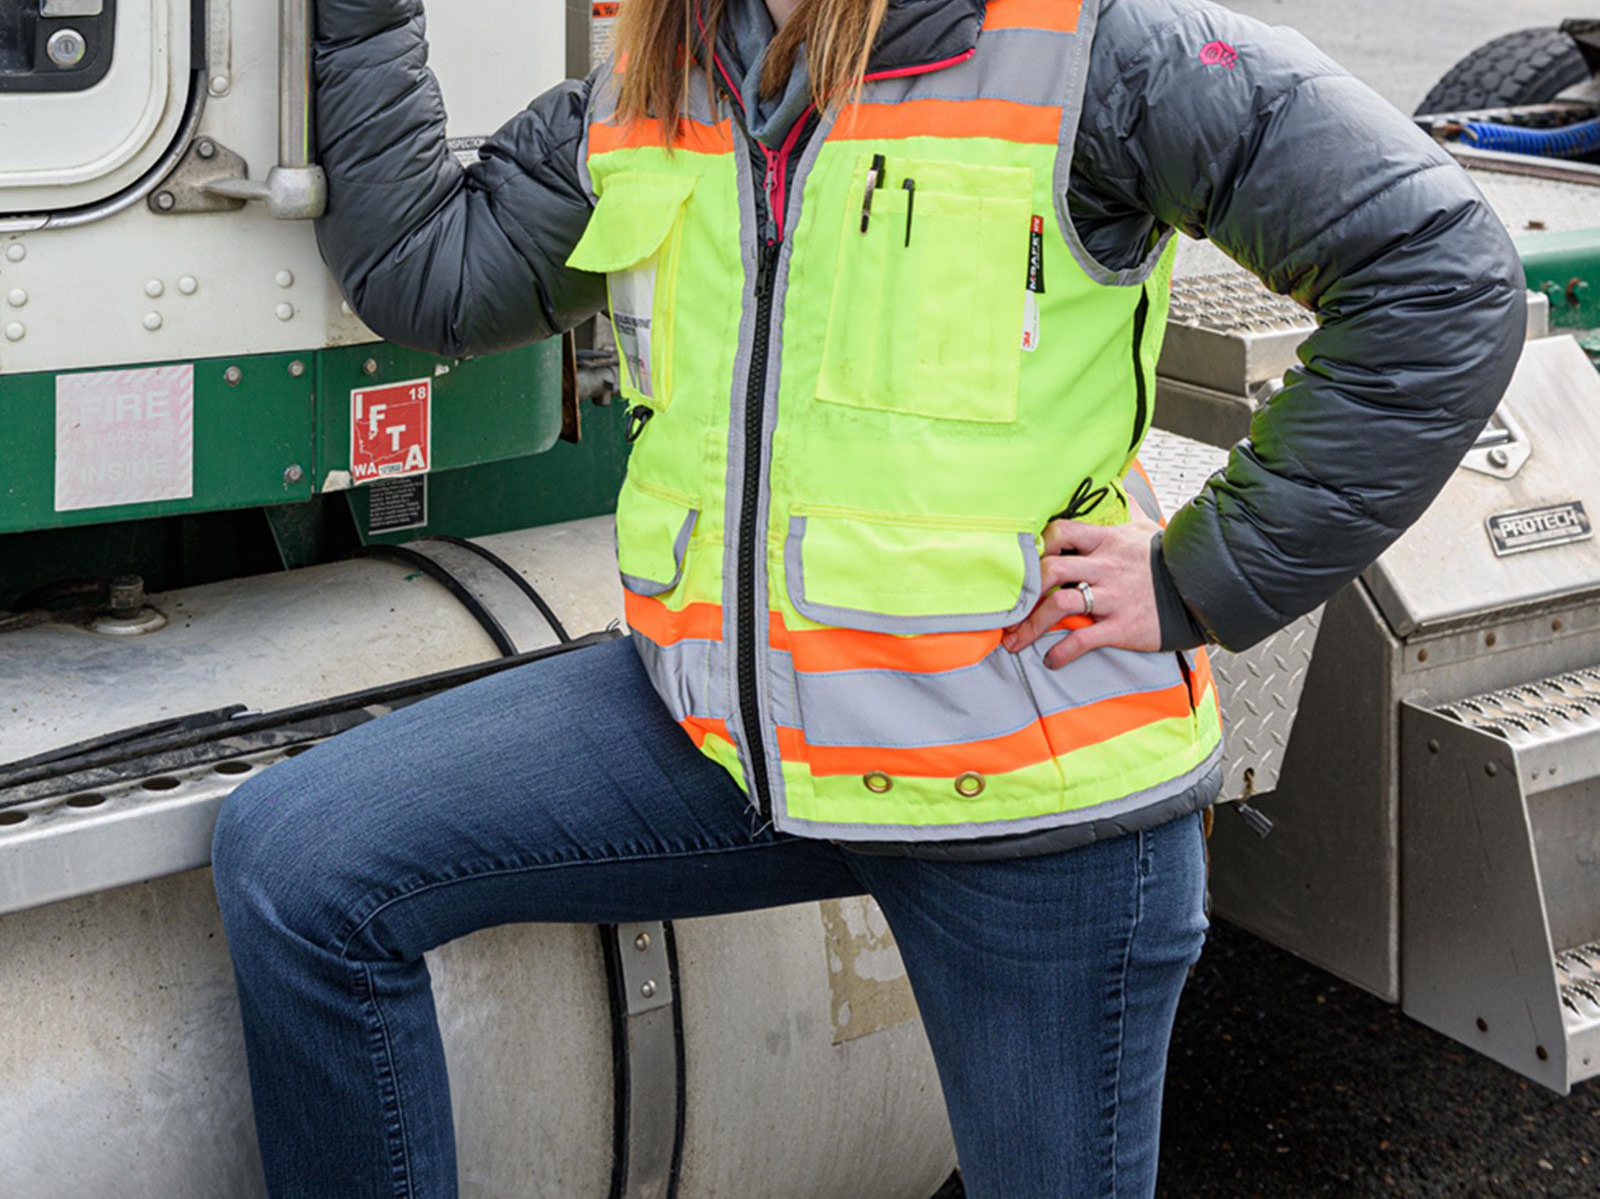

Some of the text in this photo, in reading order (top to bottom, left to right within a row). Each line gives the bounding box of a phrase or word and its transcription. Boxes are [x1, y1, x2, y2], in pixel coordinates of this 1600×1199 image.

[1023, 330, 1032, 349] 3M
[409, 386, 427, 401] 18
[79, 389, 171, 425] FIRE
[80, 458, 169, 484] INSIDE
[354, 462, 378, 477] WA
[1500, 510, 1578, 538] PROTECH
